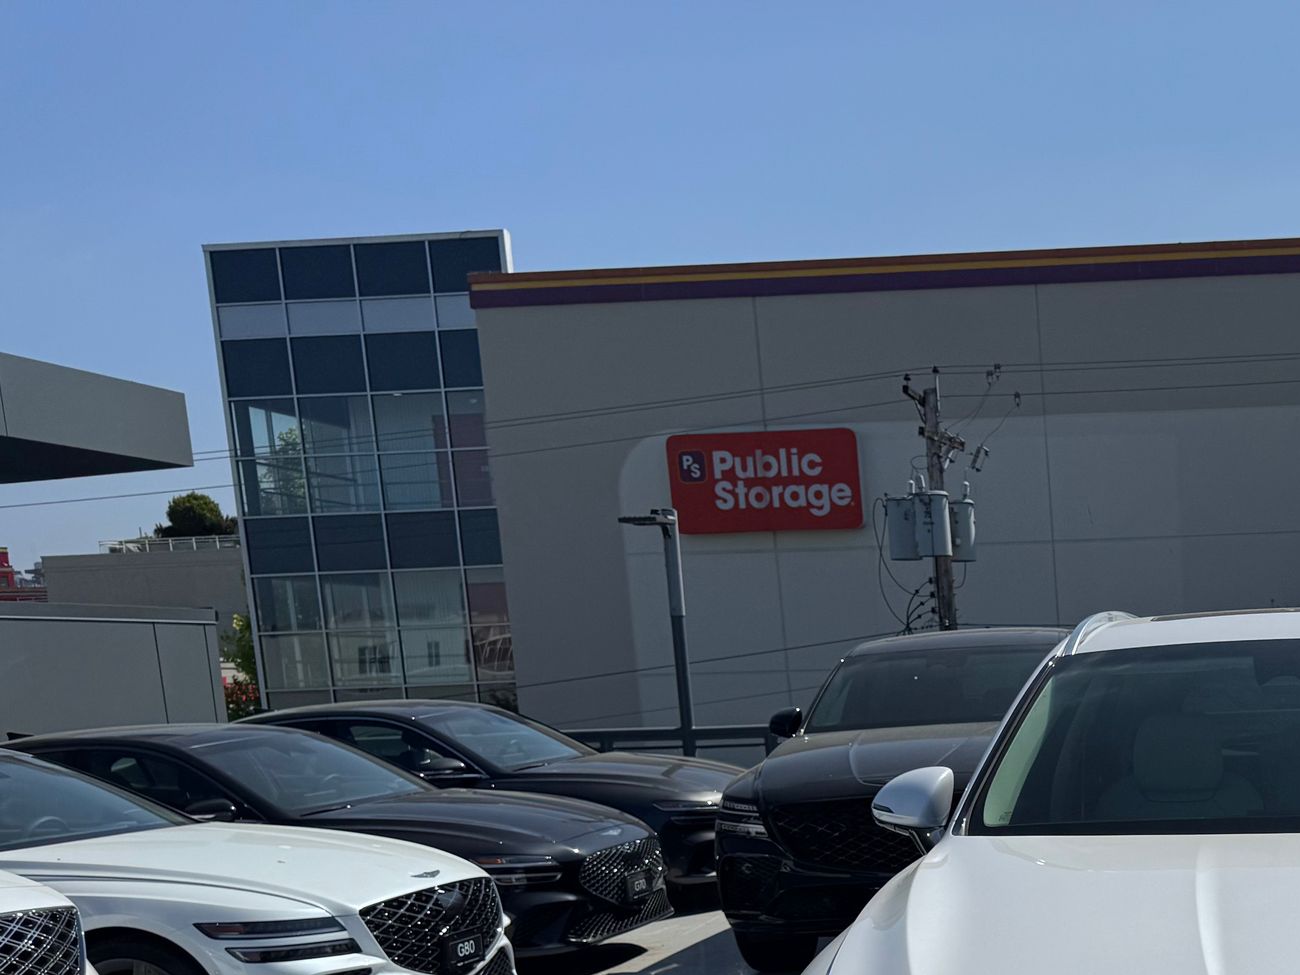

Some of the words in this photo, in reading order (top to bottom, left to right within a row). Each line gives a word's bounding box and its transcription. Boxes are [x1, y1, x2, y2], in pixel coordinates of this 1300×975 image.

[712, 448, 823, 480] Public
[714, 481, 852, 517] Storage
[457, 940, 475, 957] G80
